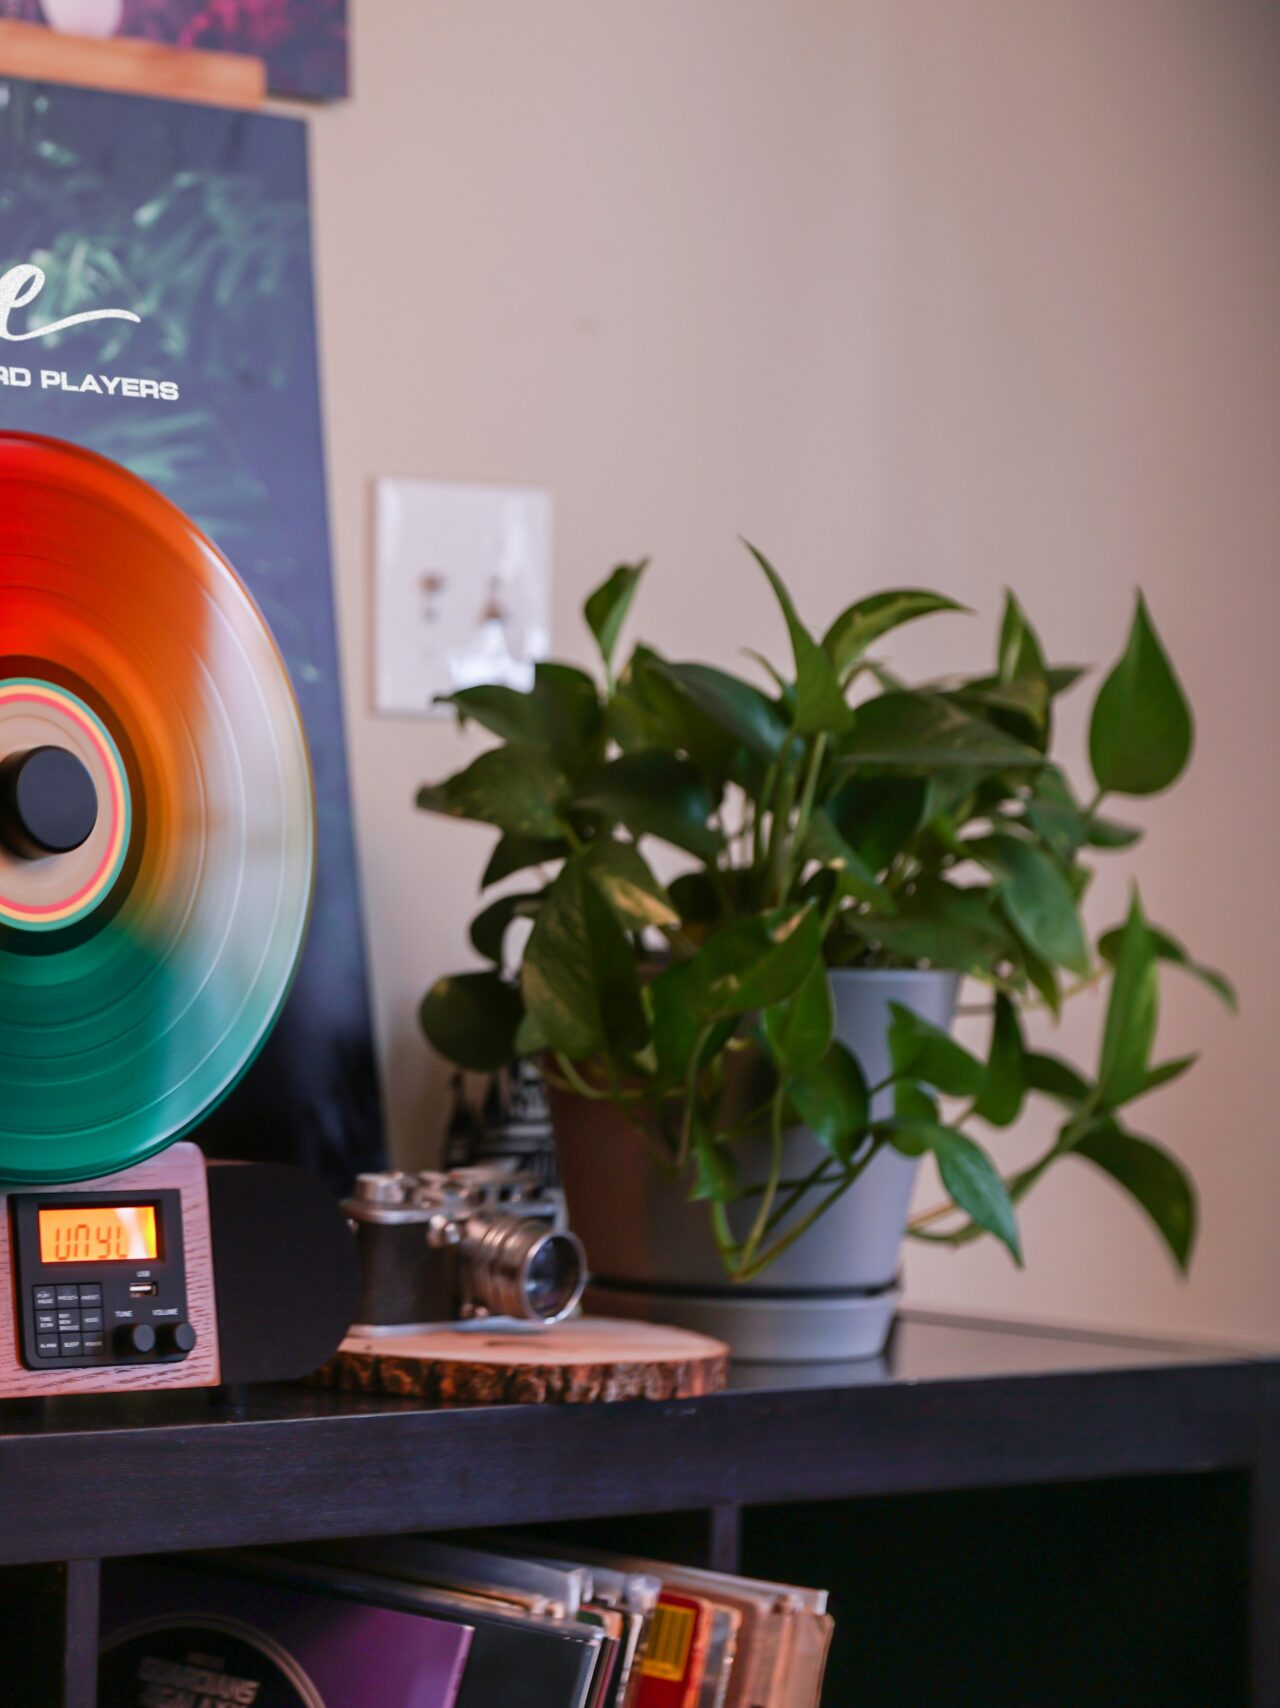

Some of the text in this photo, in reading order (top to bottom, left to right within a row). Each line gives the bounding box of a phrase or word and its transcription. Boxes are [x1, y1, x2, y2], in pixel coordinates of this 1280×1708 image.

[41, 369, 180, 401] PLAYERS
[114, 1310, 133, 1318] TUNE
[151, 1307, 179, 1316] VOLUME
